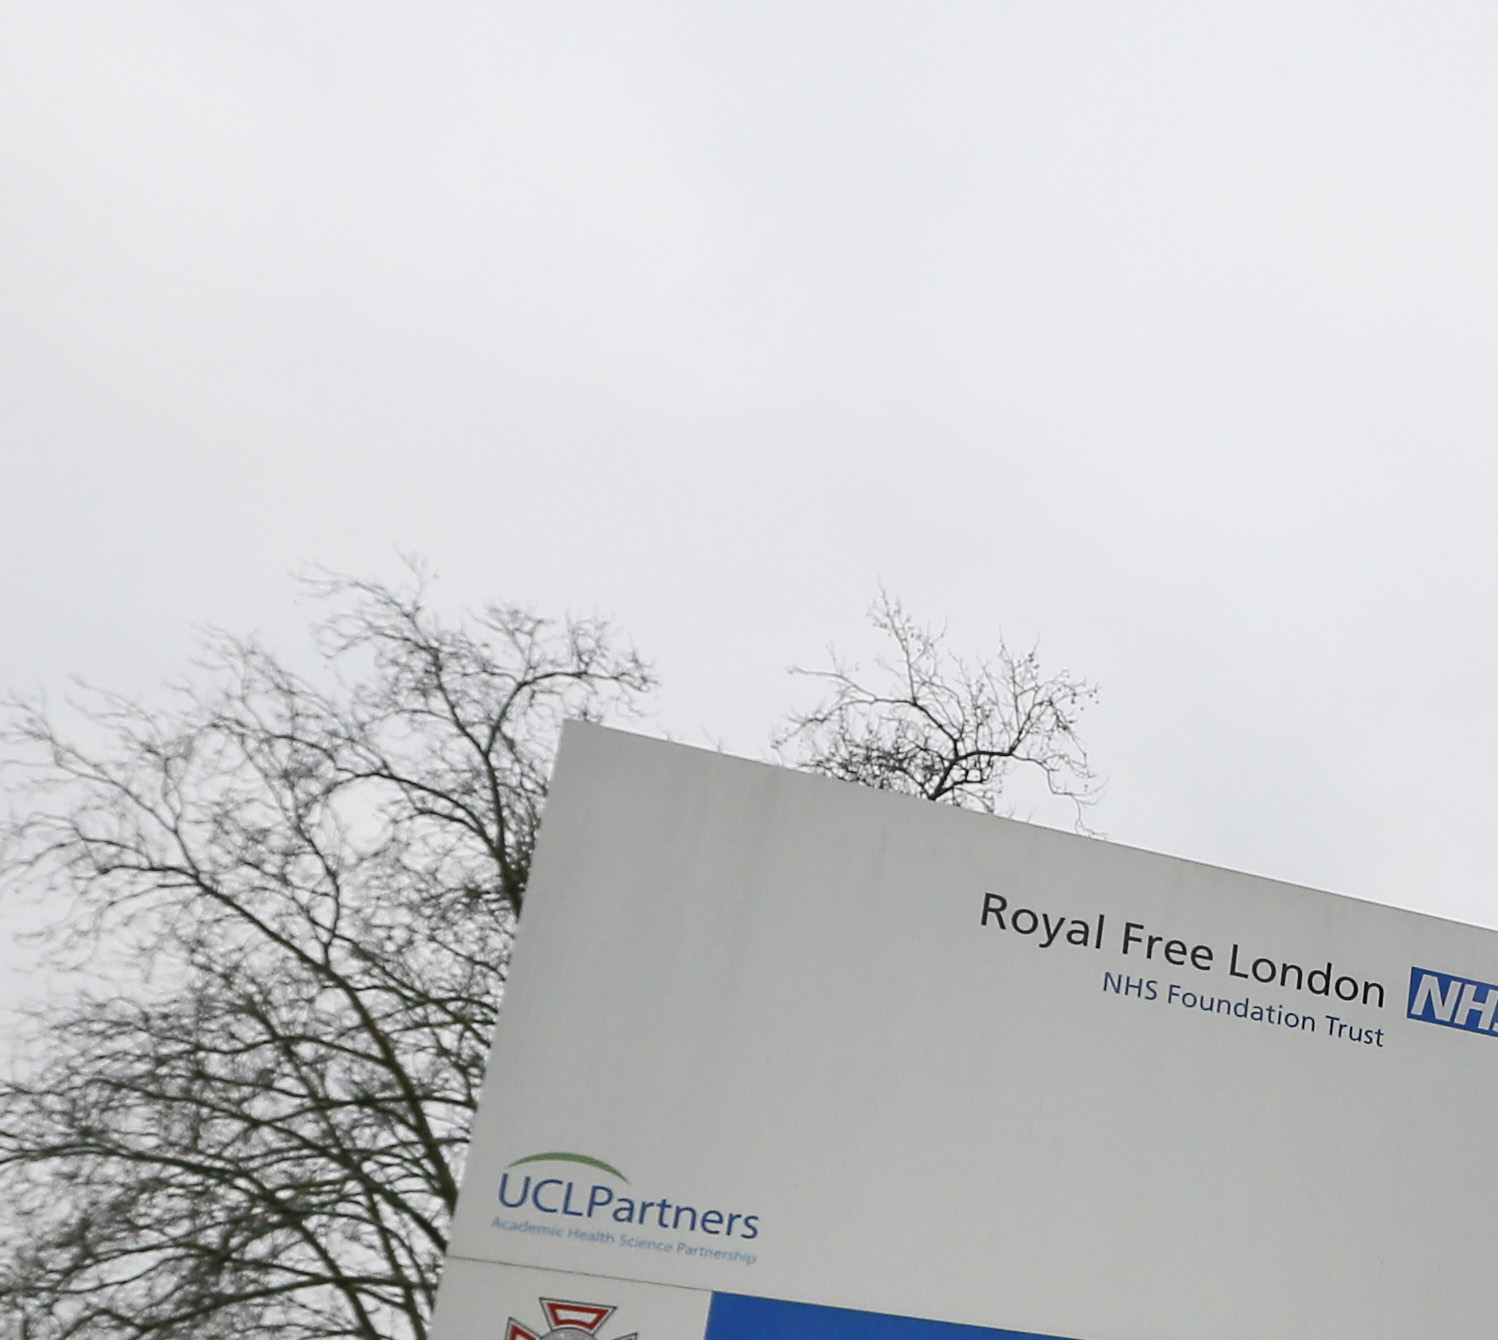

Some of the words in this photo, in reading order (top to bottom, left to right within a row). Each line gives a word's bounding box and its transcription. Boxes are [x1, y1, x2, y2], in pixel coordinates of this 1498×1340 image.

[980, 892, 1105, 950] Royal
[1121, 921, 1214, 971] Free
[1229, 943, 1385, 1009] London
[1102, 971, 1158, 1001] NHS
[1167, 984, 1316, 1033] Foundation
[1324, 1014, 1385, 1048] Trust
[490, 1216, 563, 1238] Academic
[567, 1228, 615, 1244] Health
[618, 1233, 673, 1253] Science
[676, 1241, 758, 1266] Partnership
[497, 1172, 760, 1240] UCLPartners
